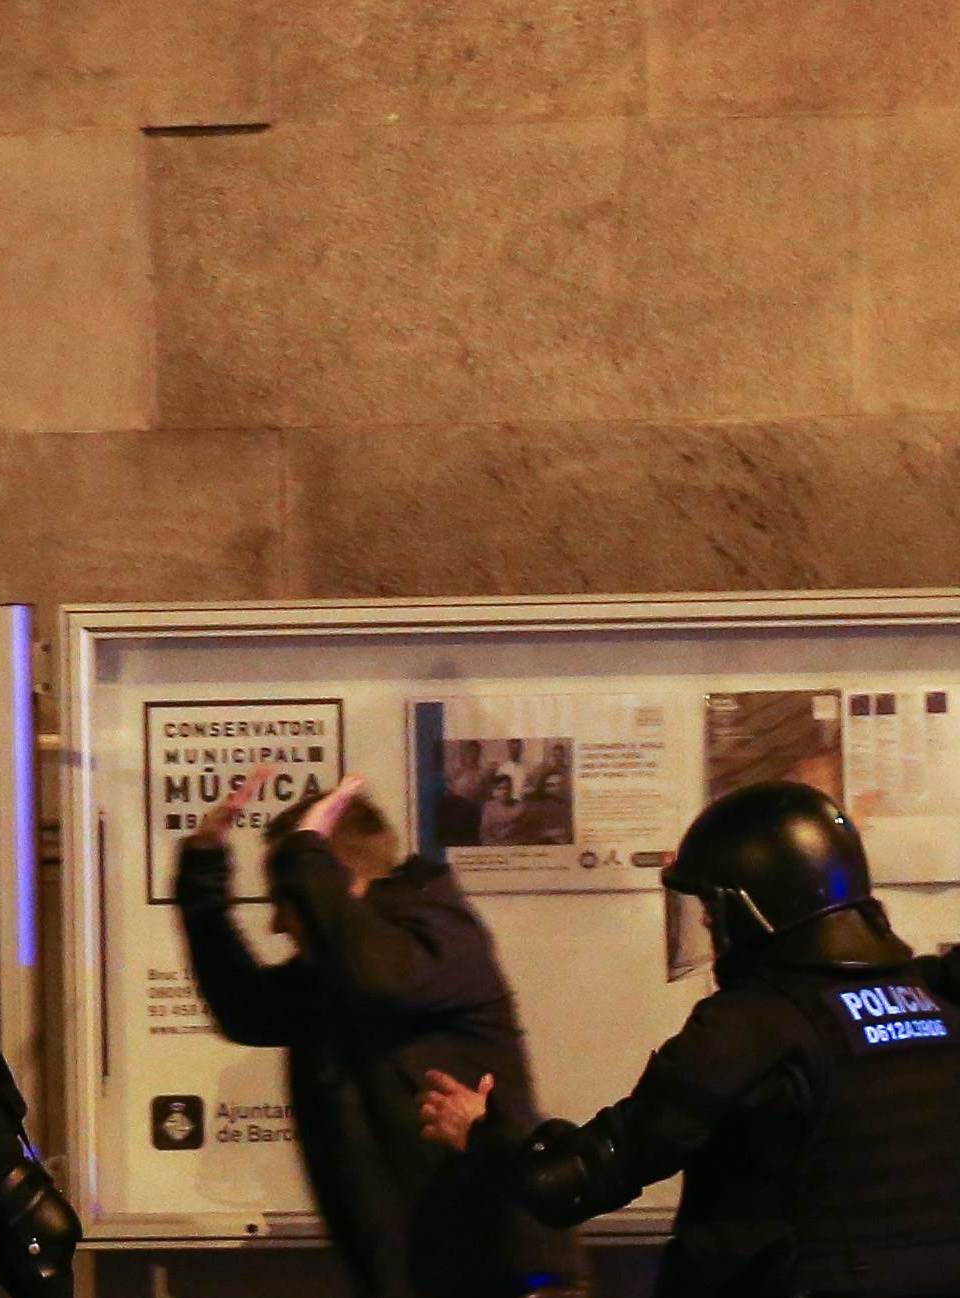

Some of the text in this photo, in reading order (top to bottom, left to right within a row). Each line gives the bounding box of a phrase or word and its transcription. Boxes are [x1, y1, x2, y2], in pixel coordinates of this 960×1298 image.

[164, 720, 325, 738] CONSERVATORI
[164, 747, 305, 764] MUNICIPAL
[840, 986, 941, 1020] POLICIA
[217, 1124, 297, 1143] de Barc
